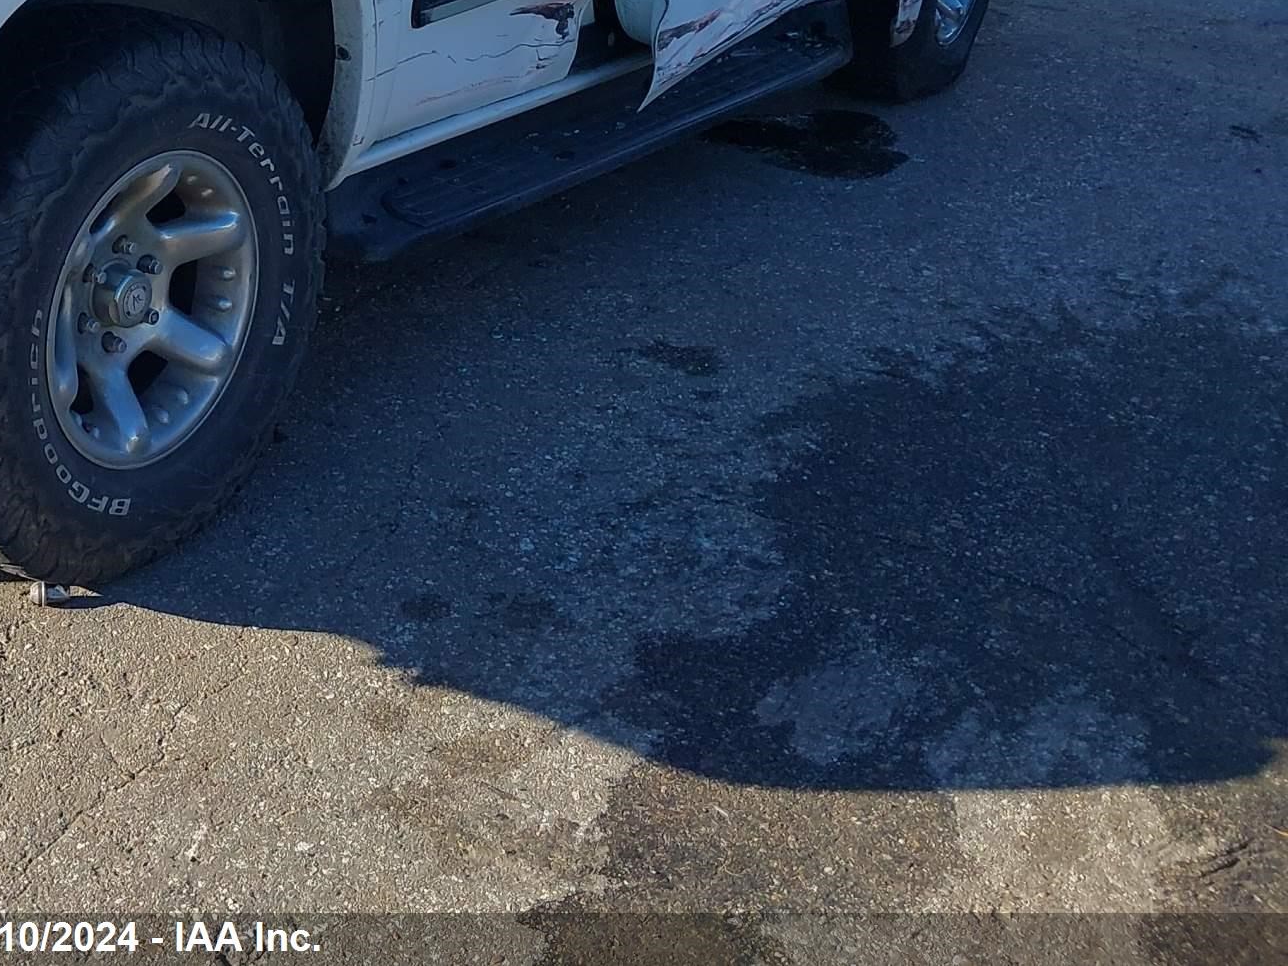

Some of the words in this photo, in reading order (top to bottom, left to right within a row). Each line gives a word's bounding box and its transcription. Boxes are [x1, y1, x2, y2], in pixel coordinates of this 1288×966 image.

[188, 113, 294, 255] All-Terrain
[272, 279, 295, 345] T/A
[30, 309, 131, 516] BFGoodrich
